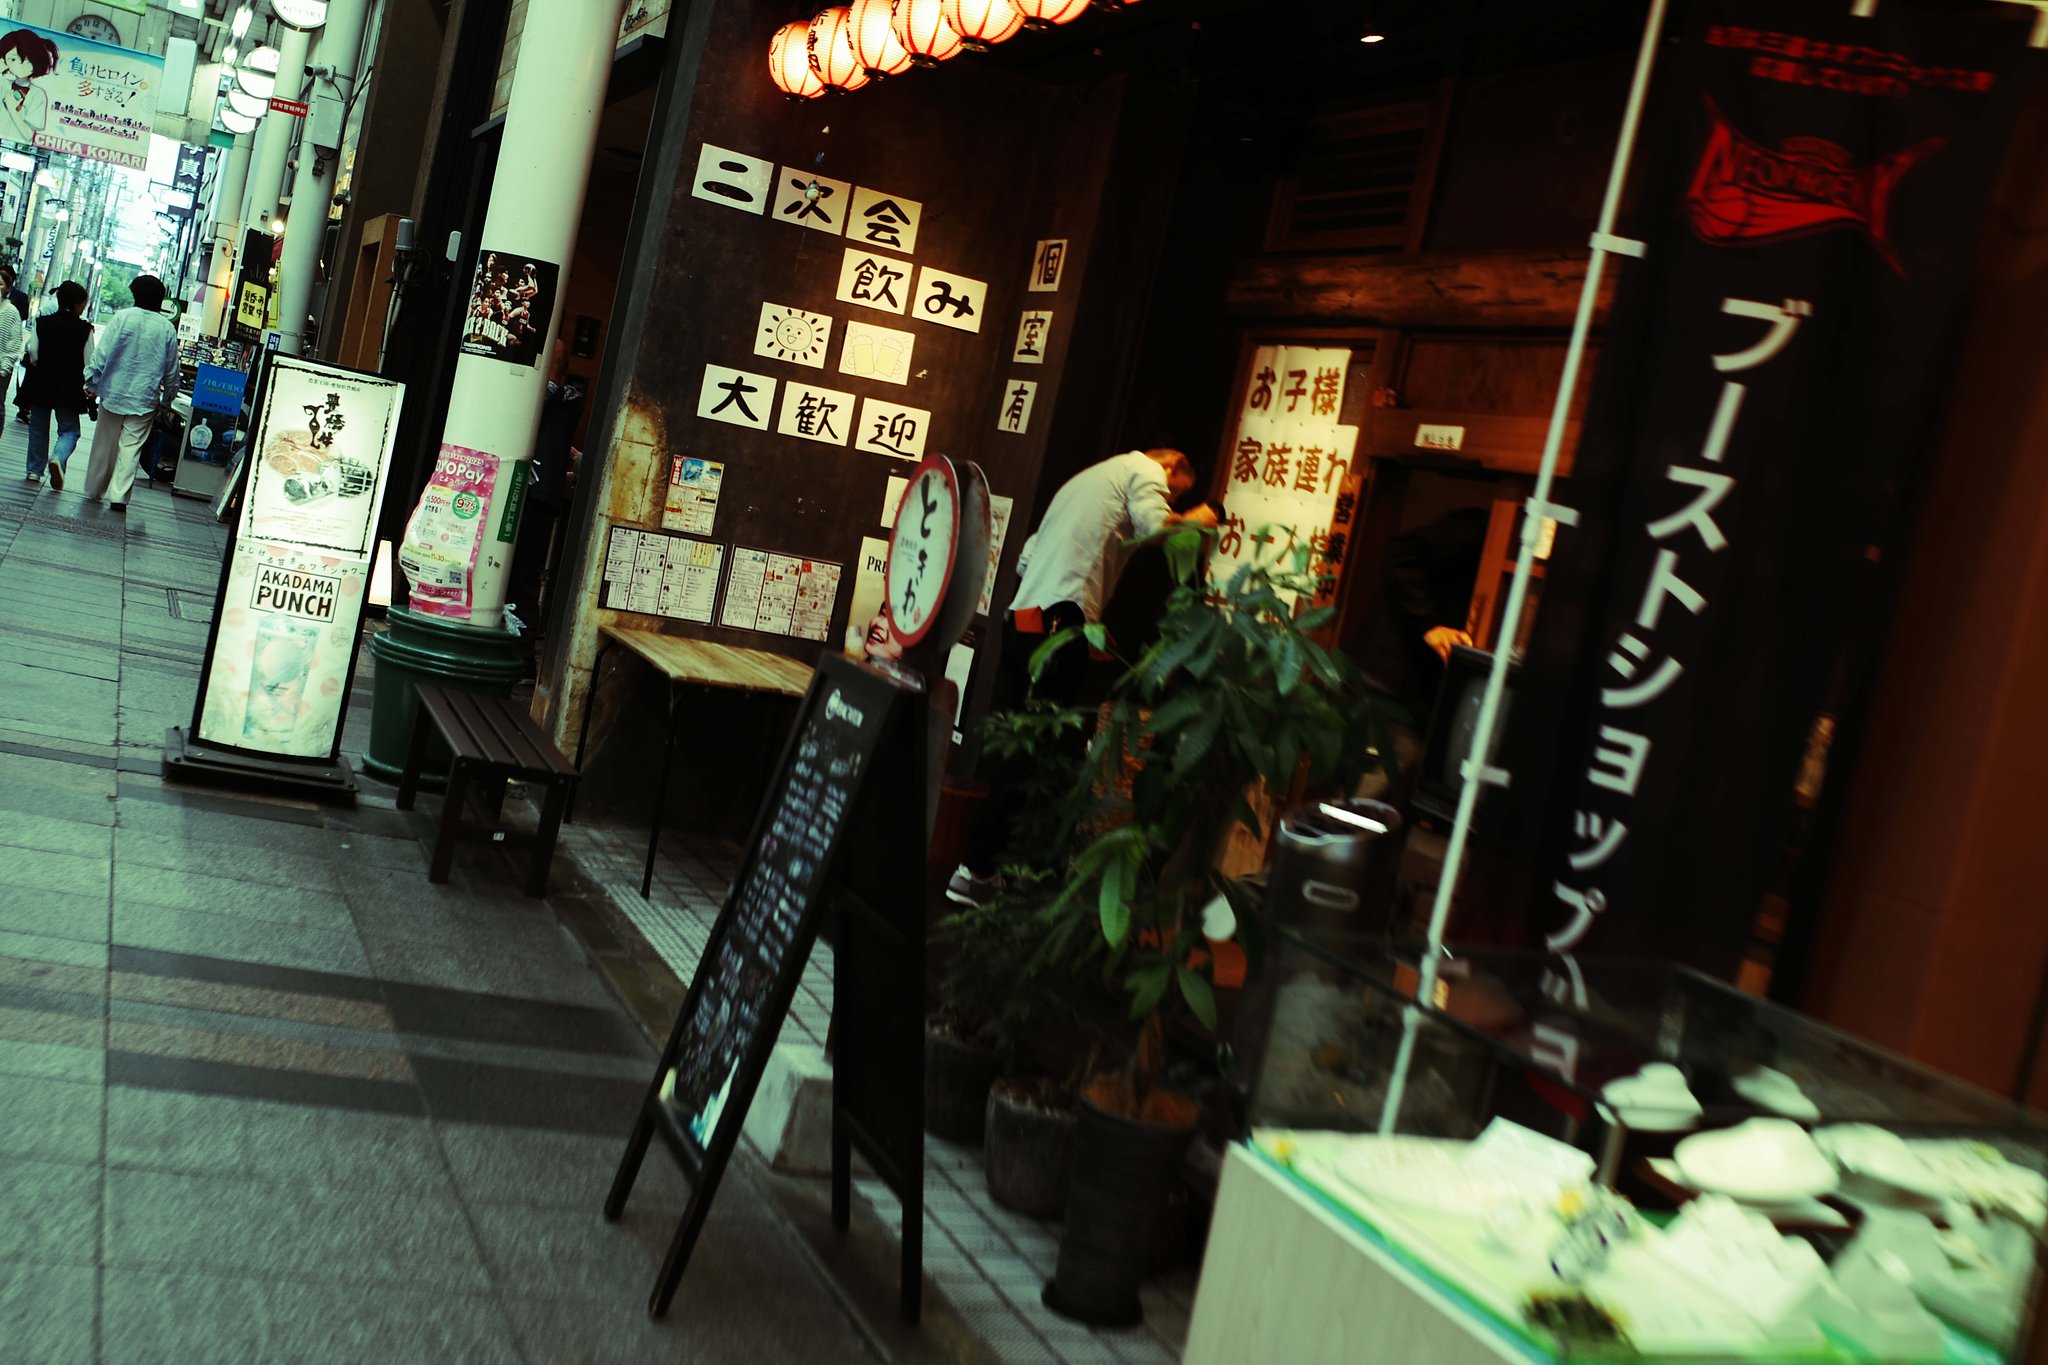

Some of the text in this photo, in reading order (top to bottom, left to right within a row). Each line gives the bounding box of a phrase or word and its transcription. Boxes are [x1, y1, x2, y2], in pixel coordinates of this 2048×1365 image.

[64, 116, 137, 140] マケインたち!
[34, 133, 146, 168] CHIKA KOMARI
[702, 160, 911, 248] 二次会
[852, 258, 975, 319] 飲み
[1002, 242, 1064, 432] 個室有
[202, 377, 244, 394] SHISEIDO
[1250, 366, 1340, 416] お子様
[710, 375, 916, 457] 大歓迎
[238, 545, 366, 577] はじける甘さのワインサワー
[261, 569, 334, 596] AKADAMA
[256, 585, 333, 618] PUNCH
